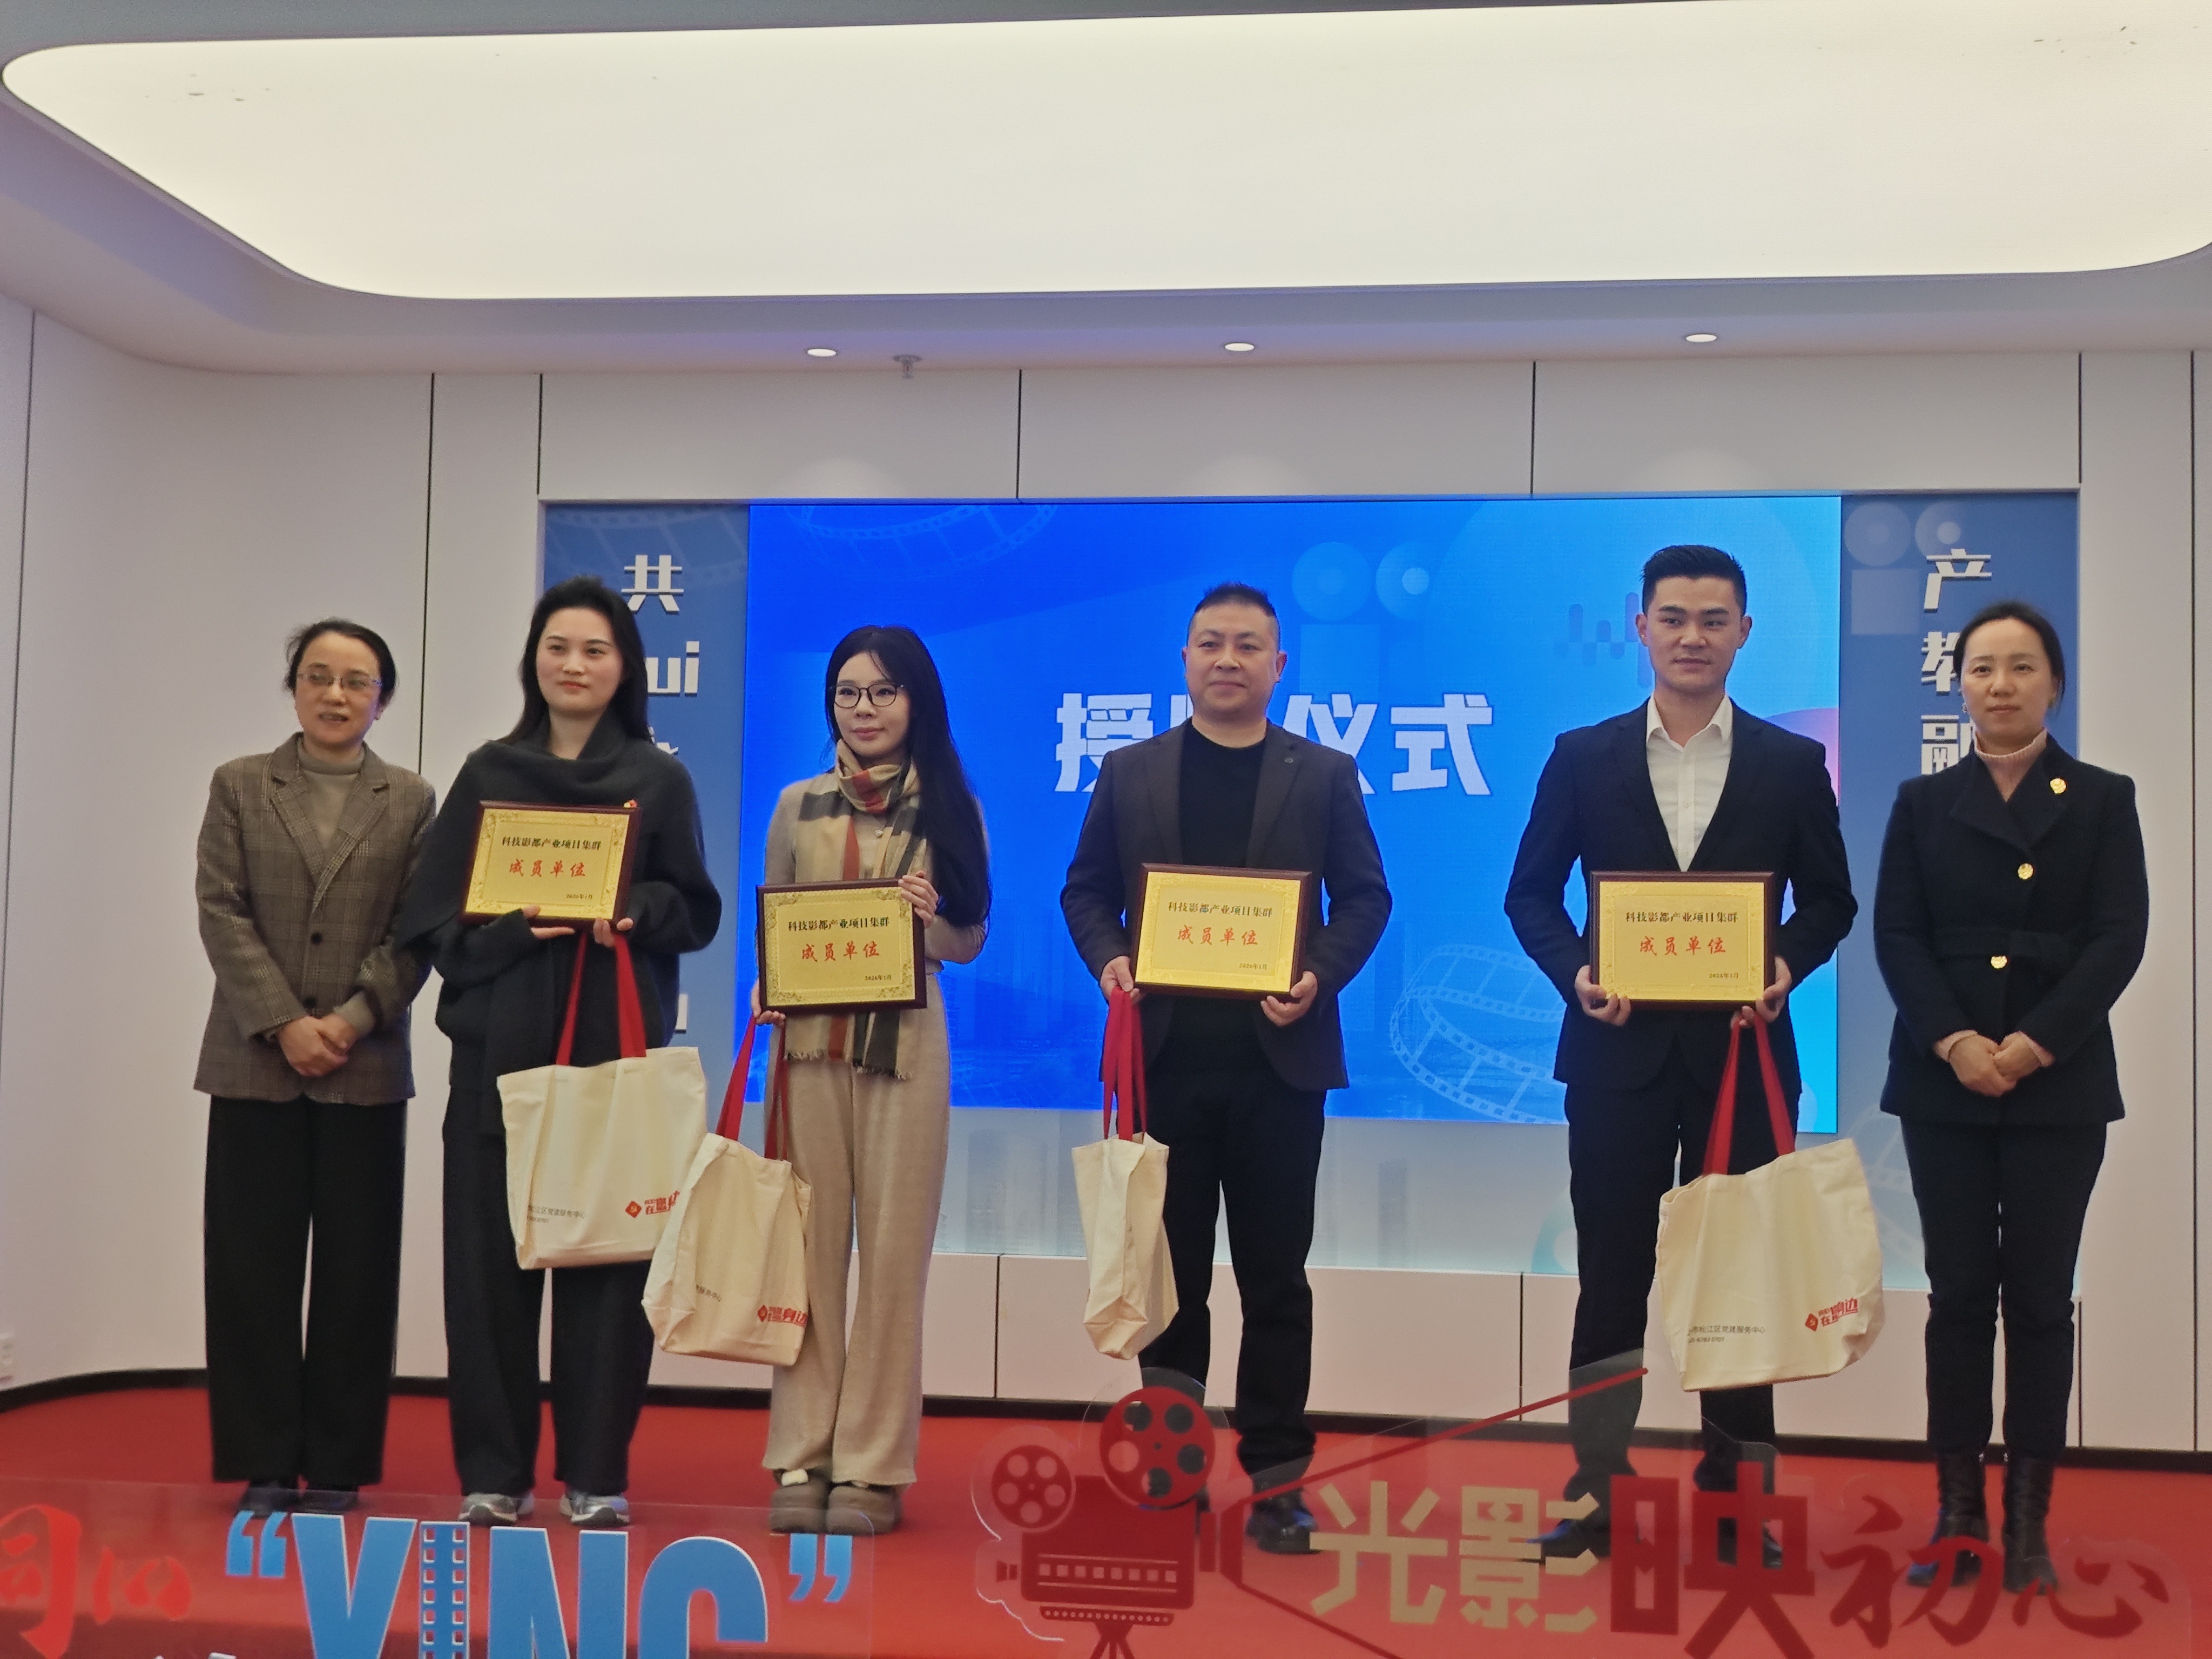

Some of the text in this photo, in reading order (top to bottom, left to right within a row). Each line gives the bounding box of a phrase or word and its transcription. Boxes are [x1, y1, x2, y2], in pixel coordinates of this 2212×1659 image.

[621, 554, 684, 613] 共
[1054, 692, 1493, 795] 授仪式
[502, 836, 602, 851] 科技影都产业项目集群
[509, 858, 585, 878] 成员单位
[1168, 901, 1273, 918] 科技影都产业项目集群
[1626, 911, 1738, 923] 科技影都产业项目集群
[788, 916, 889, 931] 科技影都产业项目集群
[1177, 925, 1258, 946] 成员单位
[1640, 935, 1726, 956] 成员单位
[801, 940, 880, 962] 成员单位
